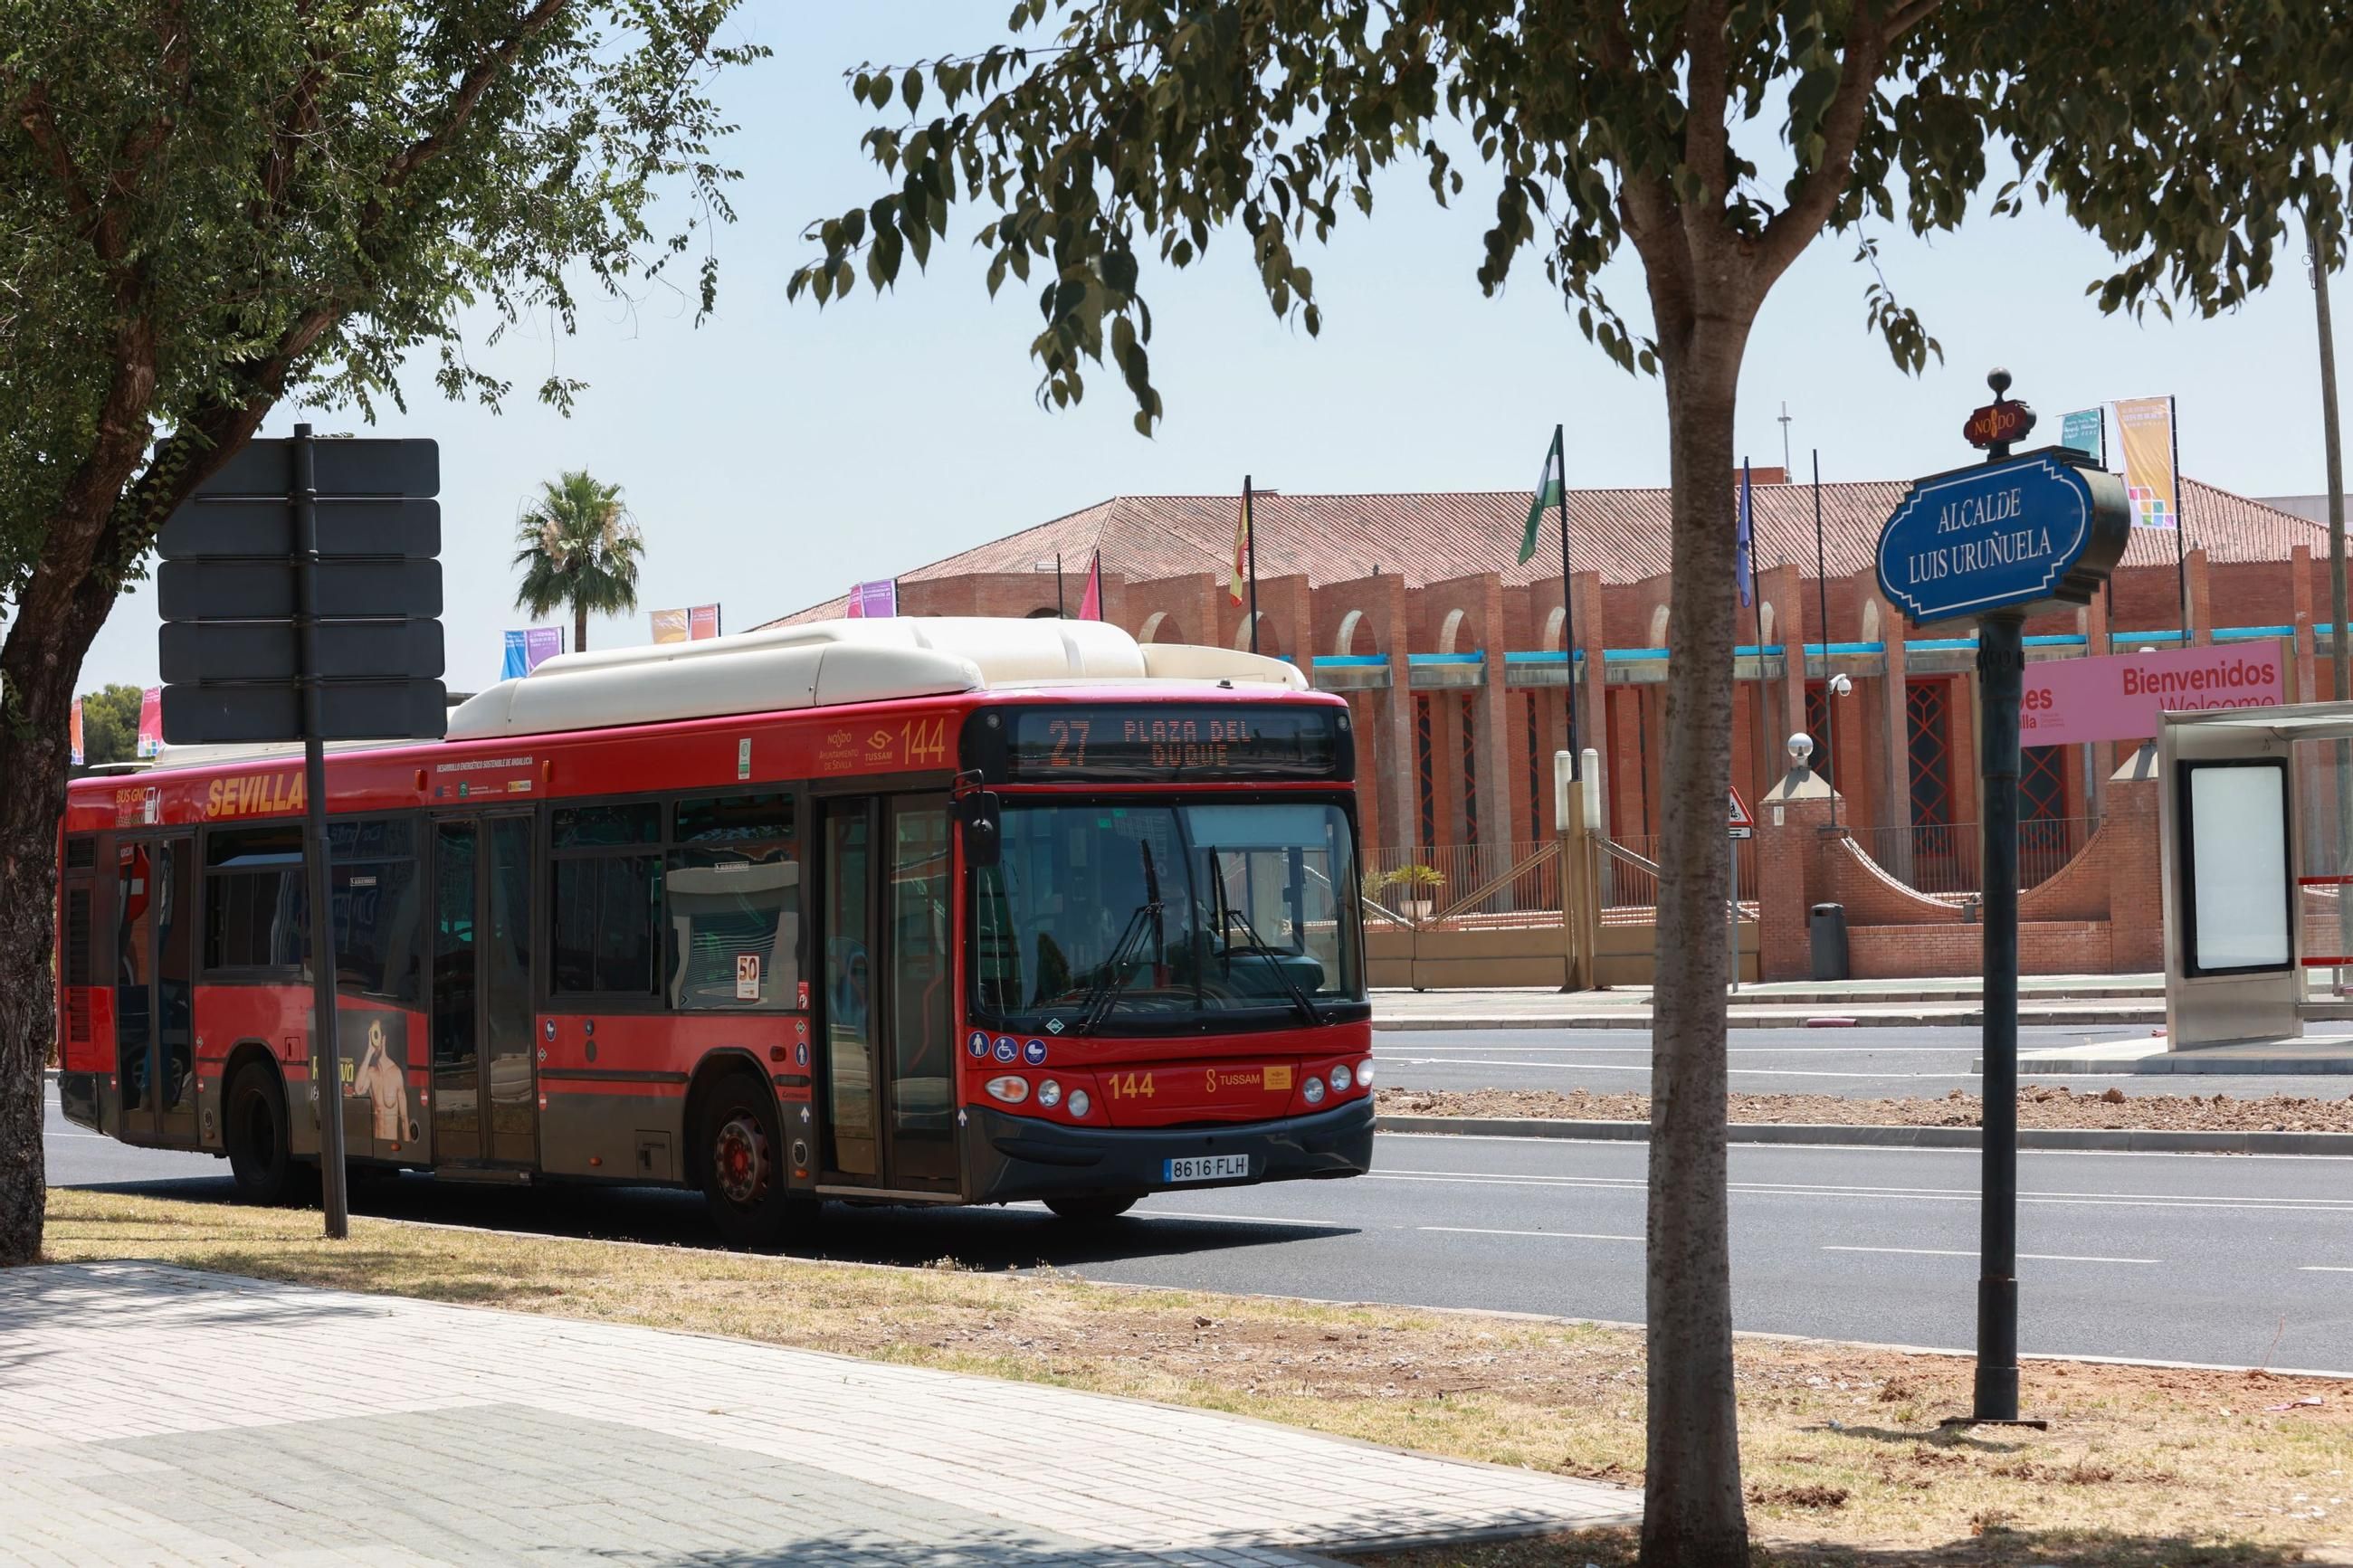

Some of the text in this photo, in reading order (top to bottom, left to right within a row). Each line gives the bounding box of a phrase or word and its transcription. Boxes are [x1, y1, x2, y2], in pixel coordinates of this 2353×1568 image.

[1938, 488, 2022, 534] ALCALDE
[1910, 526, 2053, 584] LUIS URUÑUELA
[2122, 659, 2275, 696] Bienvenidos
[900, 717, 946, 765] 144
[1049, 720, 1090, 766] 27
[1124, 721, 1251, 742] PLAZA DEL
[865, 751, 892, 762] TUSSAM
[1151, 745, 1228, 767] DUQUE
[116, 786, 147, 804] BUS GNC
[206, 772, 304, 817] SEVILLA
[738, 957, 757, 982] 50
[1109, 1072, 1155, 1099] 144
[1220, 1074, 1261, 1086] TUSSAM
[1174, 1157, 1244, 1178] 8616 FLH
